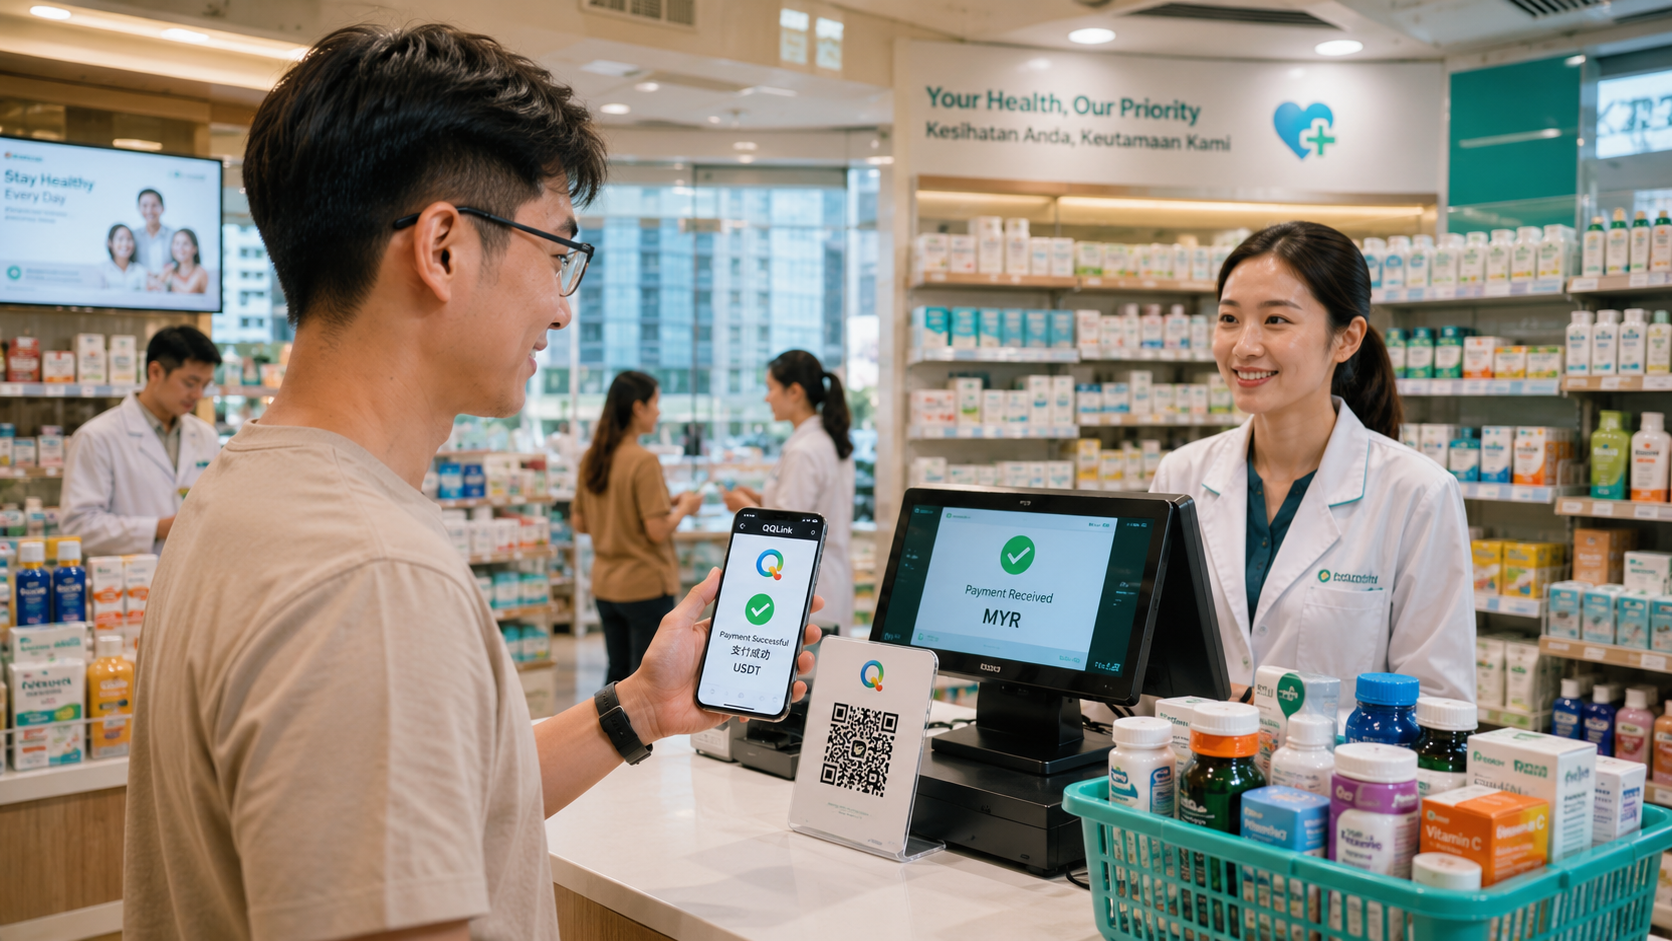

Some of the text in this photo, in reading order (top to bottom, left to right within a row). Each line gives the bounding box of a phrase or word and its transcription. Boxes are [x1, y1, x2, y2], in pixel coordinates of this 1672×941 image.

[925, 86, 1201, 127] Your Health, Our Priority
[925, 121, 1232, 152] Kesihatan Anda, Keutamaan Kami
[4, 168, 95, 194] Stay Healthy
[4, 187, 66, 206] Every Day
[762, 524, 793, 534] QQLink
[965, 584, 1054, 604] Payment Received
[982, 607, 1022, 628] MYR
[719, 630, 790, 647] Payment Successful
[733, 662, 762, 675] USDT
[1426, 824, 1482, 851] Vitamin C
